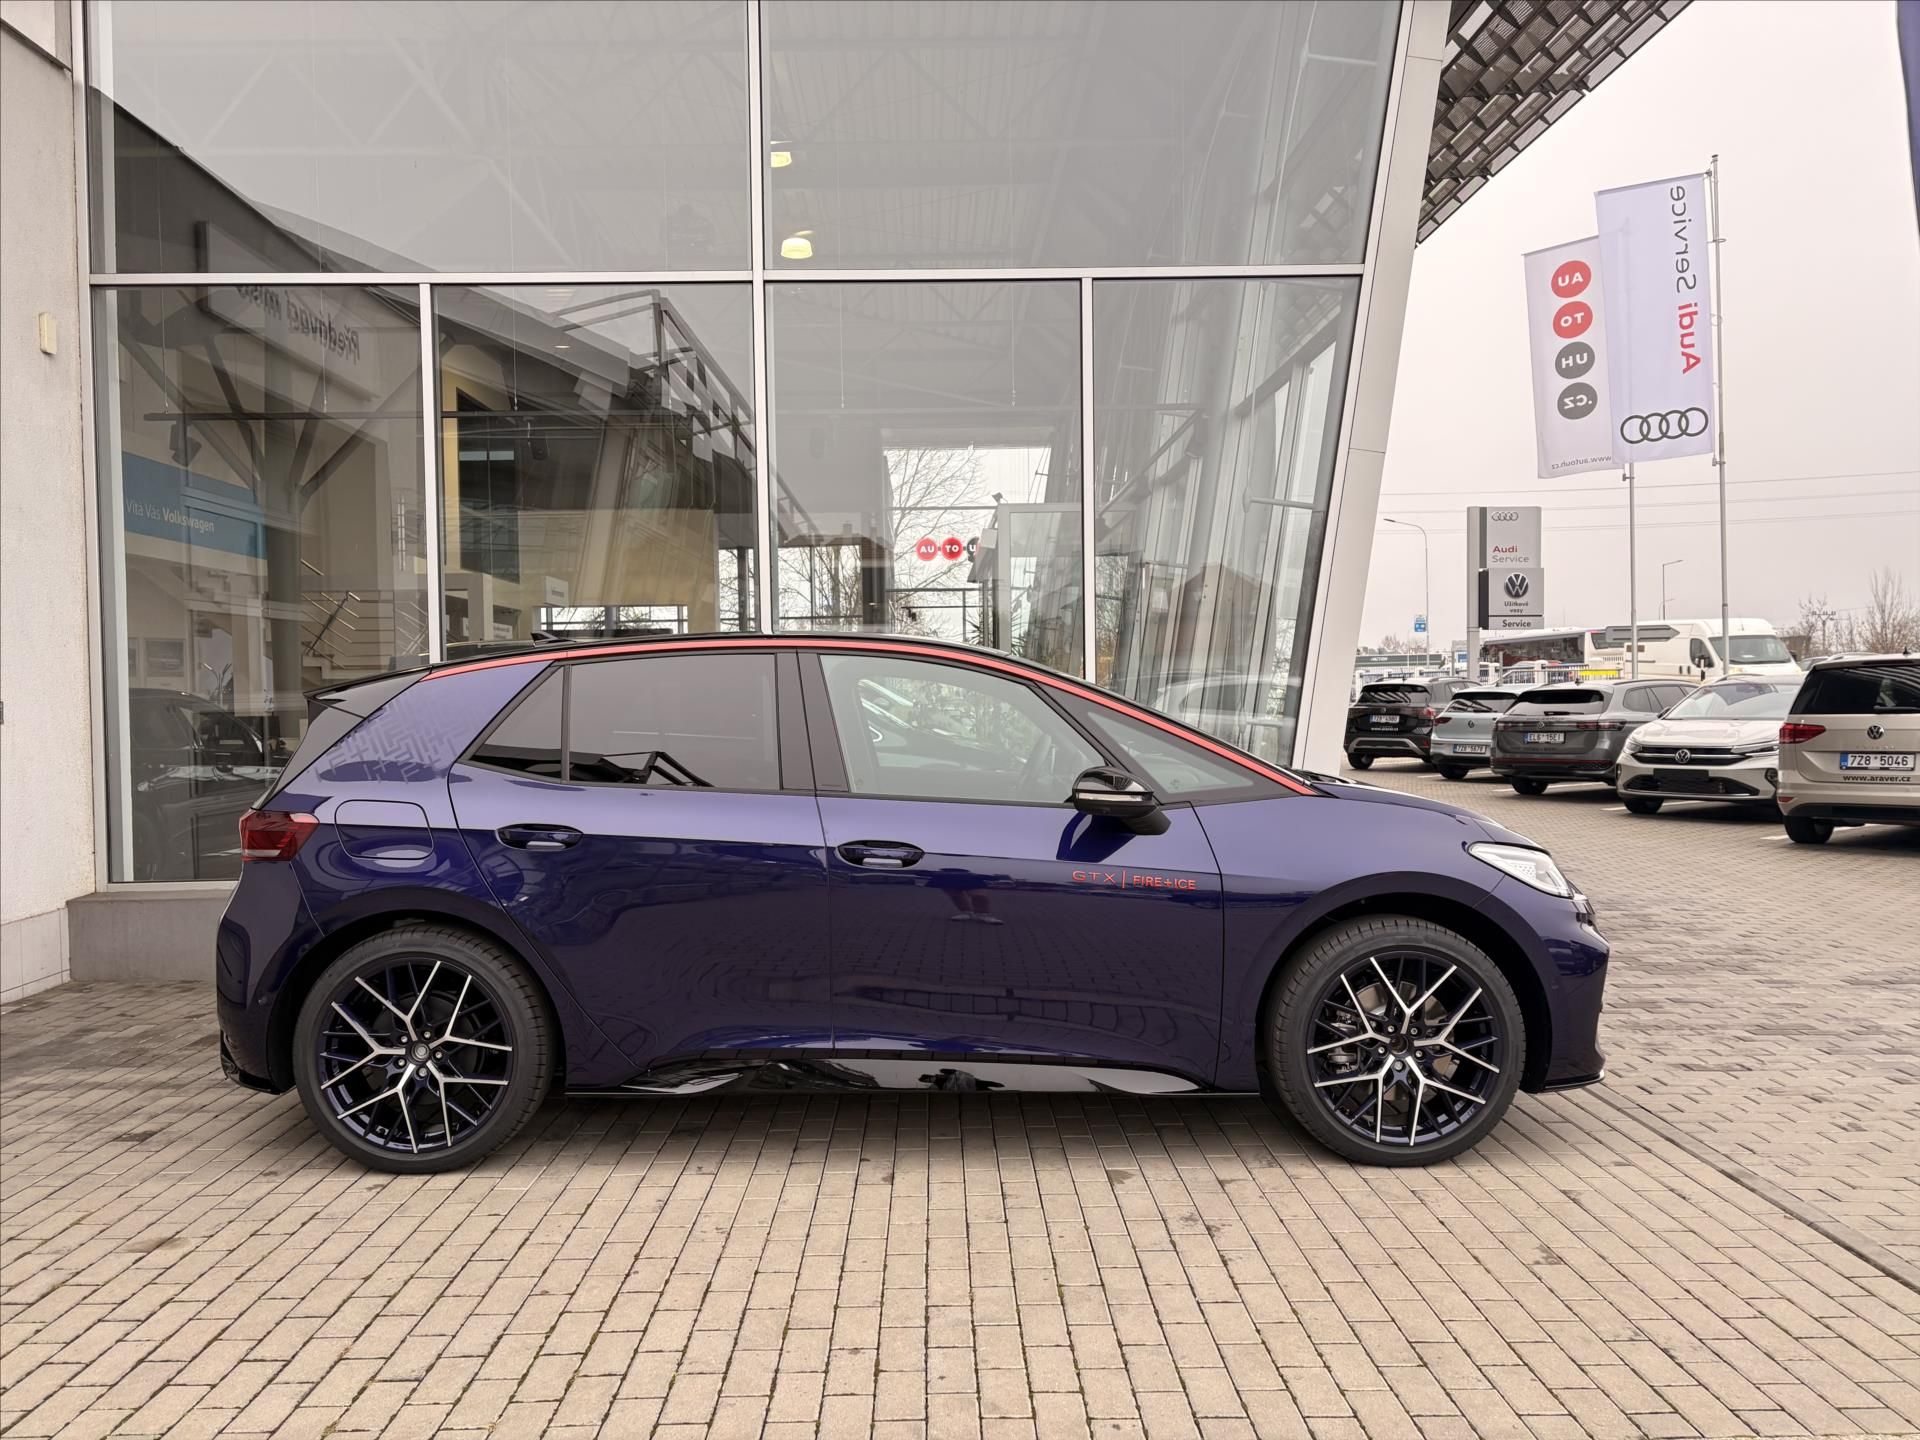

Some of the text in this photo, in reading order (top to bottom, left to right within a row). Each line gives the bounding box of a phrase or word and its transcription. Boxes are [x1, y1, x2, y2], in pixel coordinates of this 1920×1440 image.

[162, 506, 215, 533] Volkswagen
[945, 544, 959, 553] TO
[1493, 545, 1518, 553] Audi
[1492, 555, 1530, 563] Service
[1502, 619, 1532, 628] Service
[1850, 755, 1909, 767] 7Z8 5046
[1072, 870, 1197, 890] GTX FIRE+ICE
